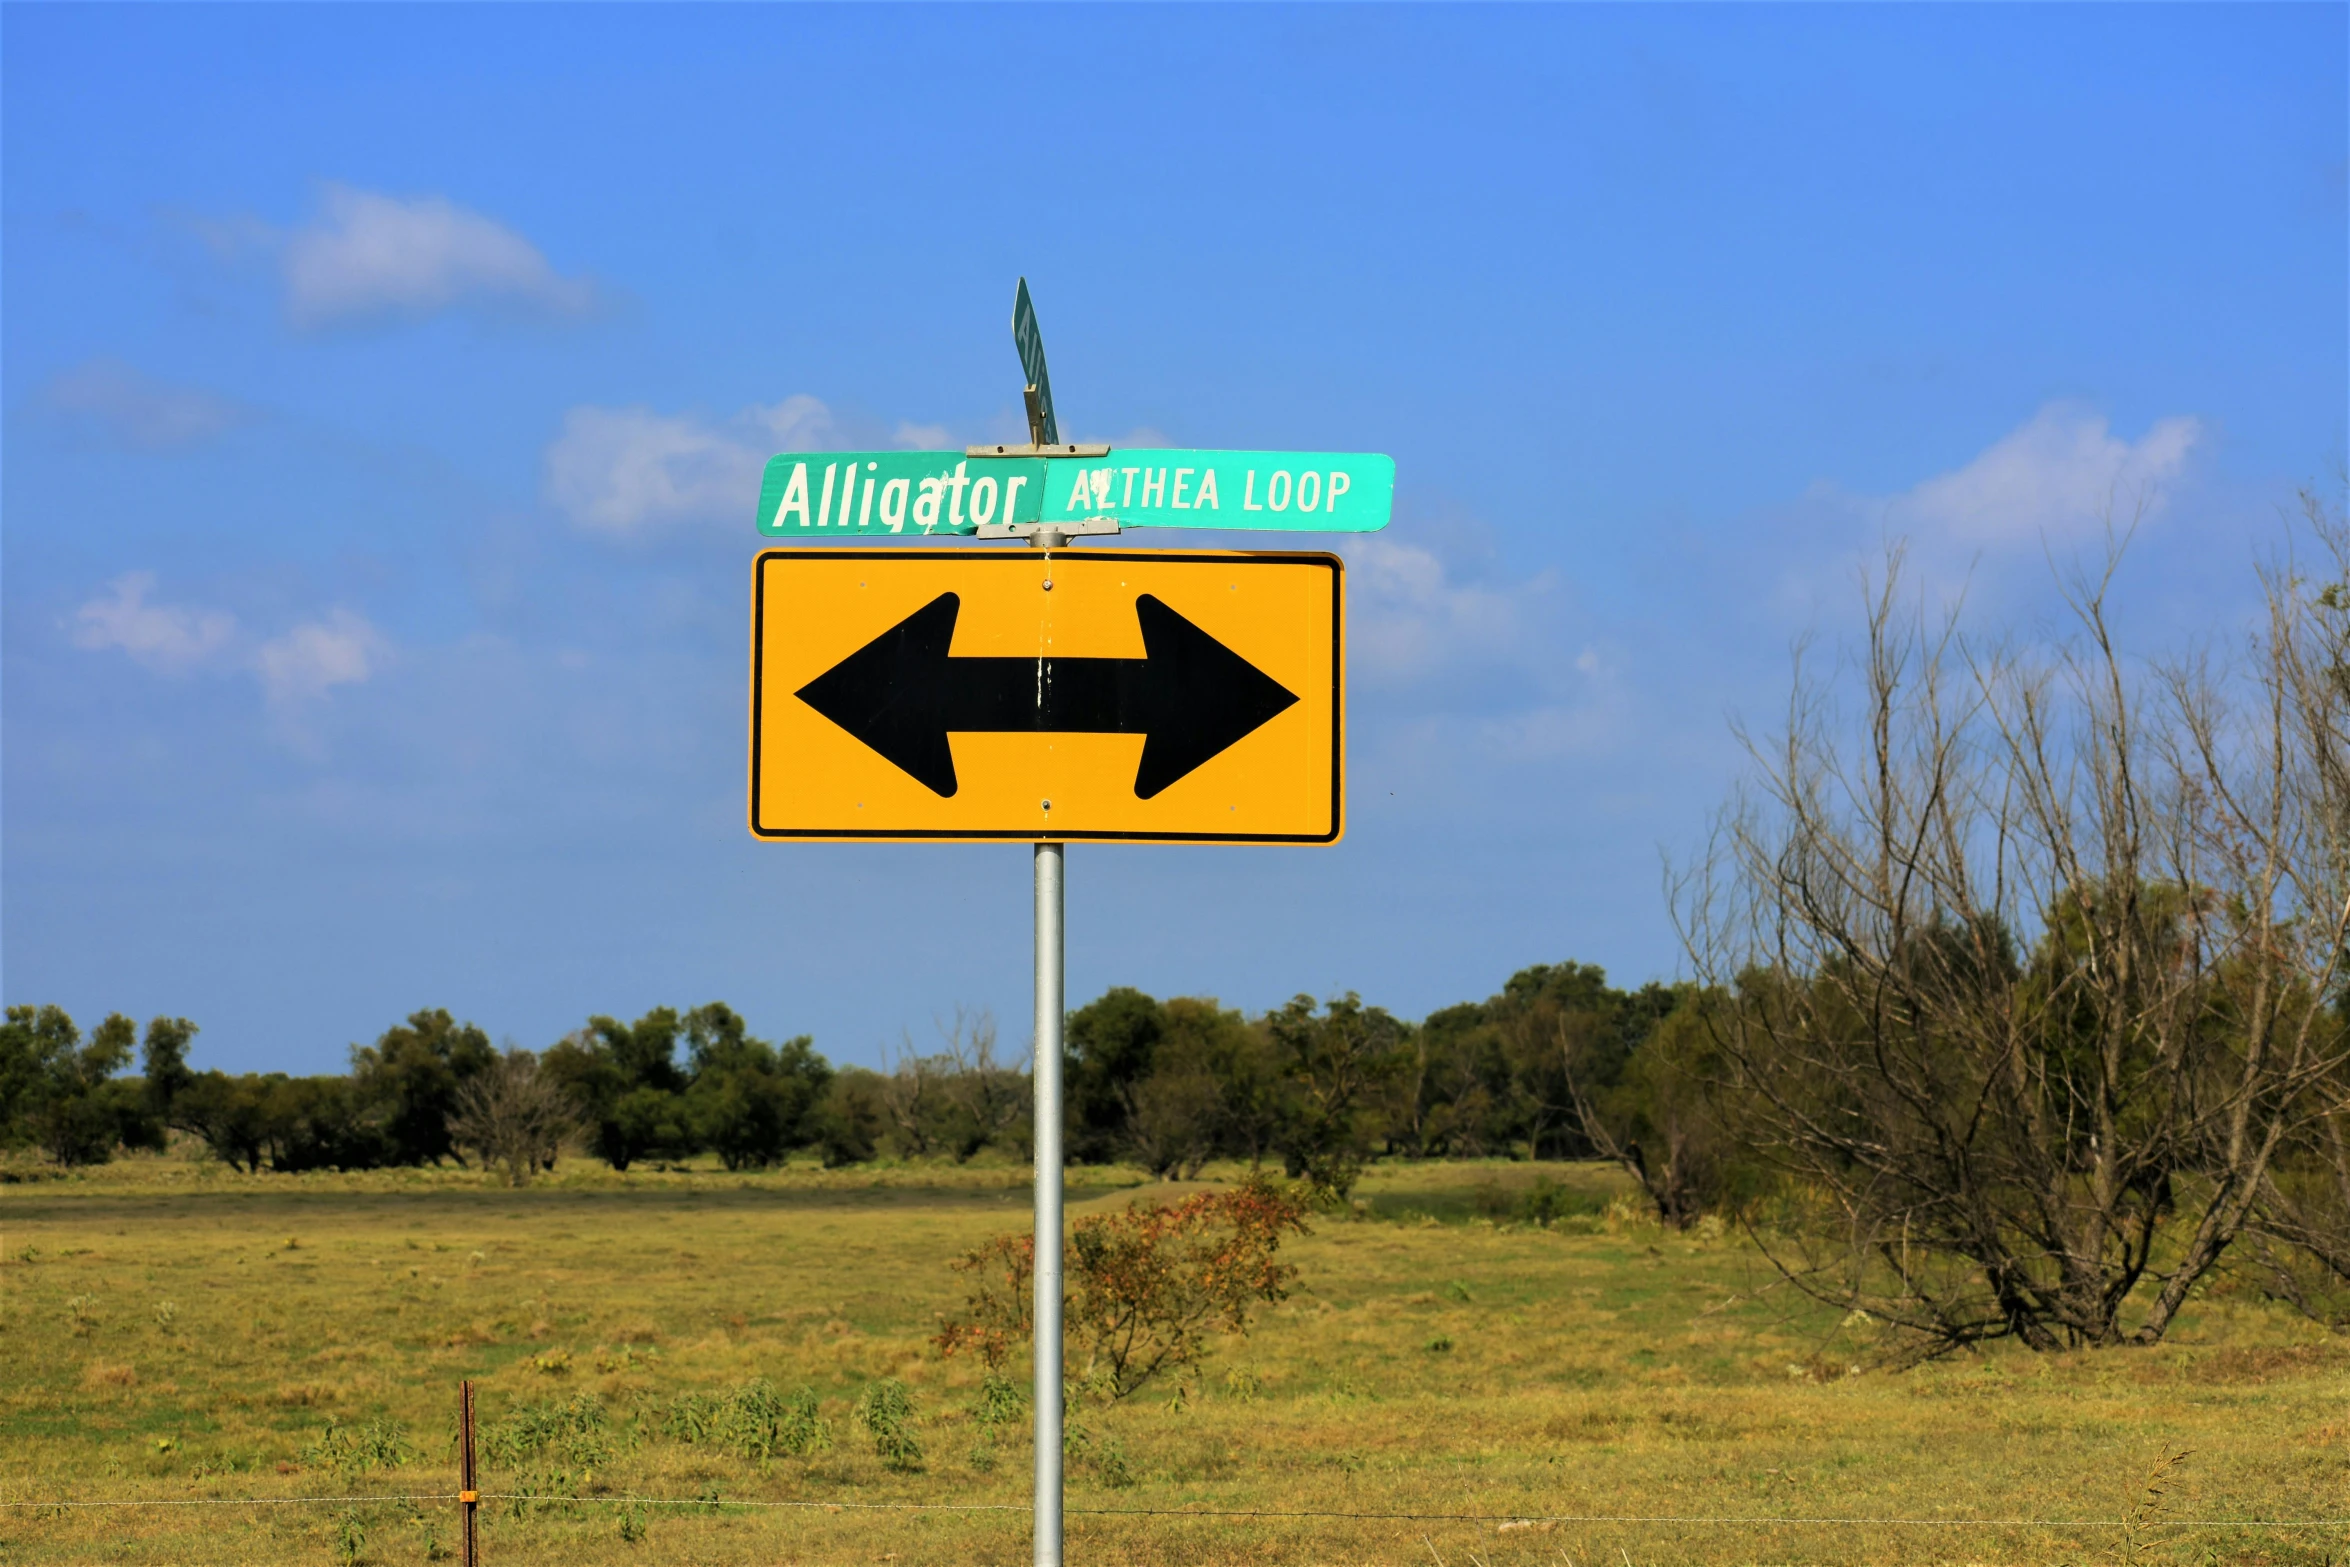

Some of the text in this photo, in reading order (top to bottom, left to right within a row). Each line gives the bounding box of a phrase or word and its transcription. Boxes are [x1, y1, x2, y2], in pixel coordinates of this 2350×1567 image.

[772, 460, 1027, 533] Alligator
[1066, 467, 1350, 512] ALTHEA LOOP
